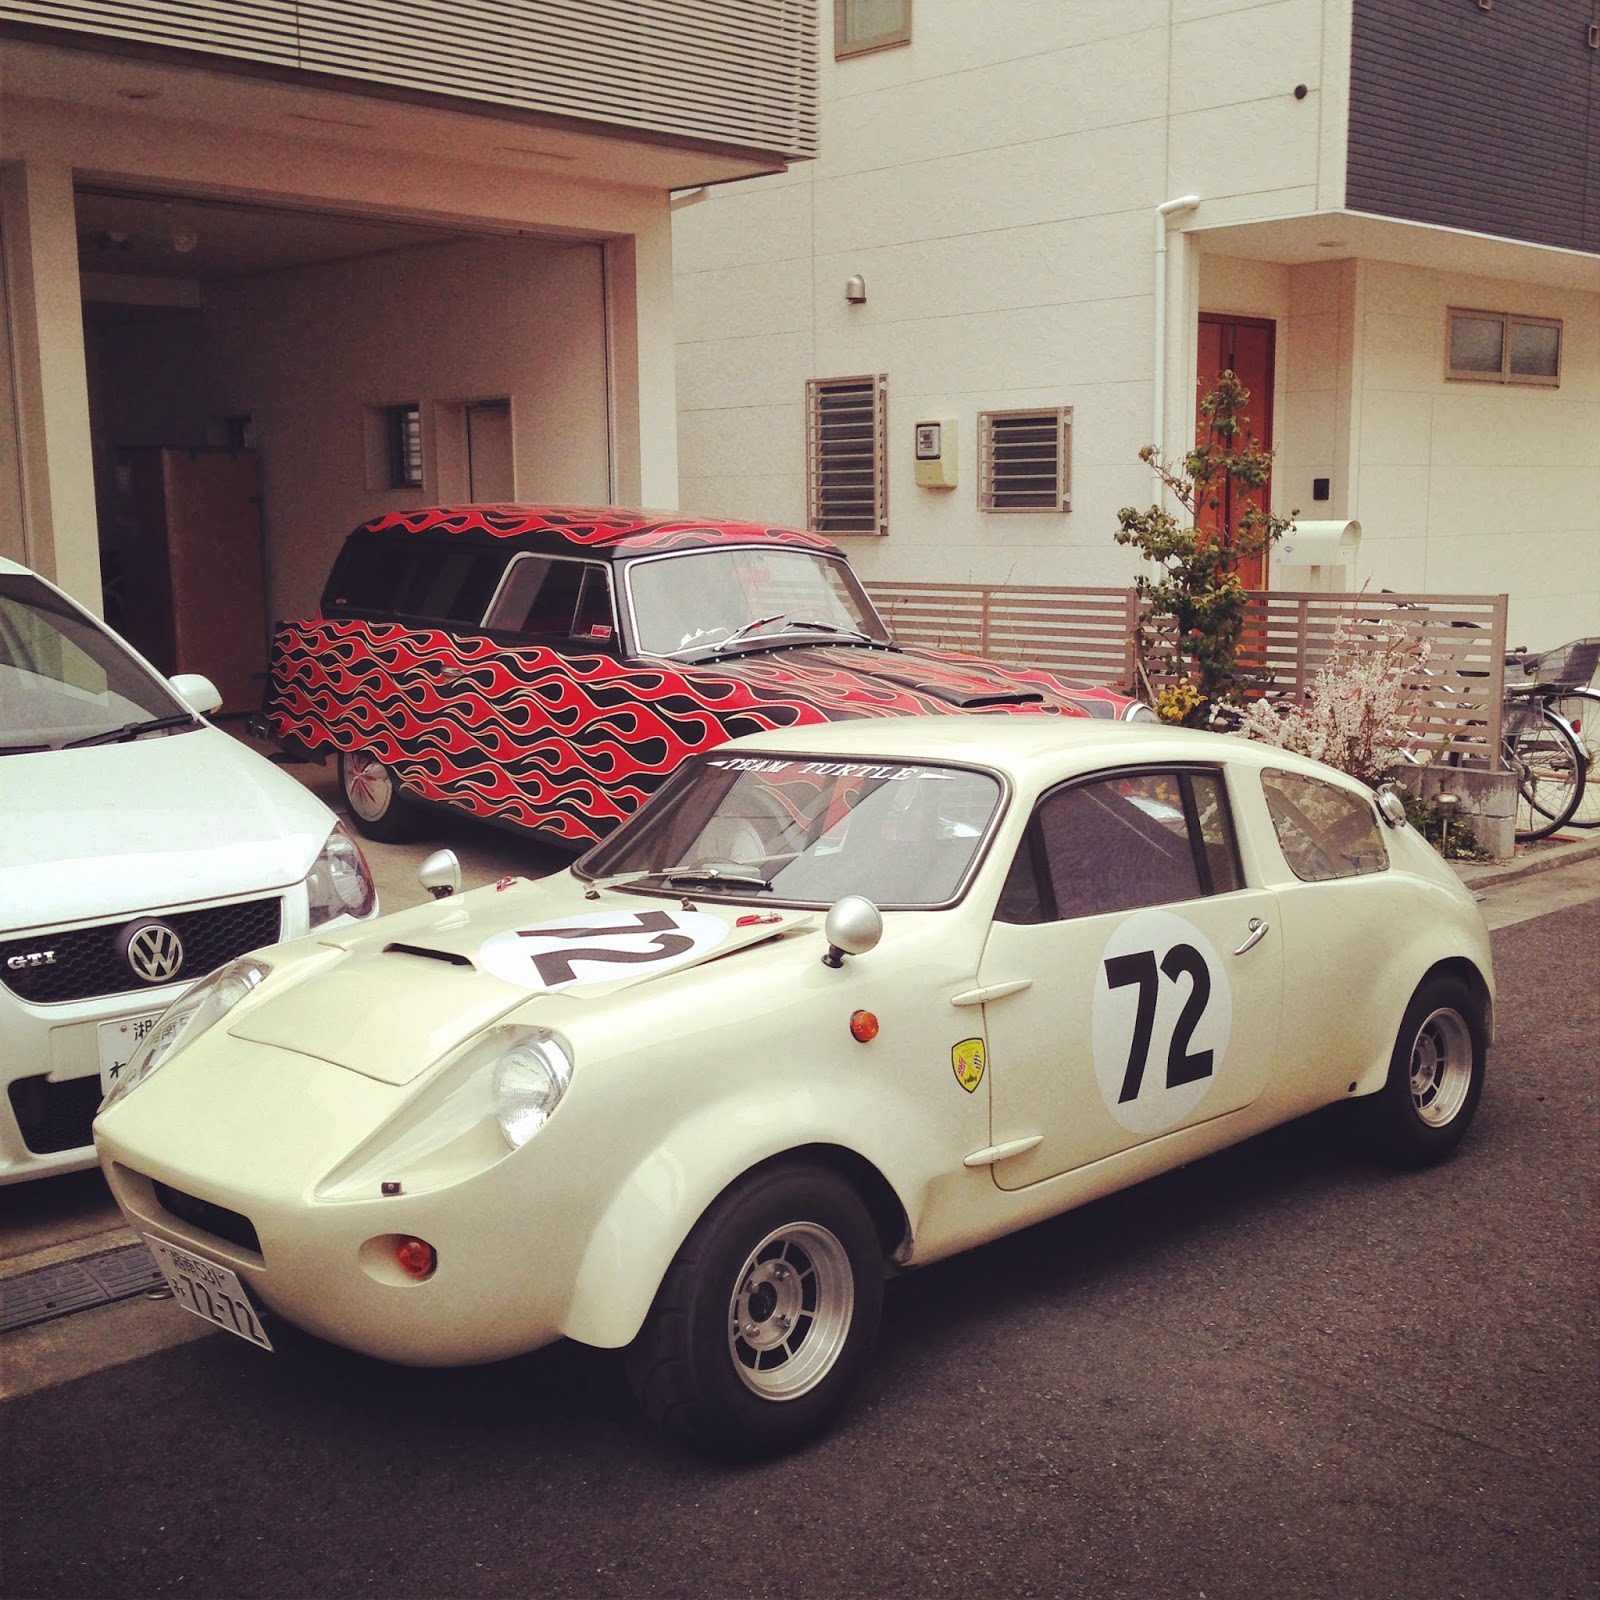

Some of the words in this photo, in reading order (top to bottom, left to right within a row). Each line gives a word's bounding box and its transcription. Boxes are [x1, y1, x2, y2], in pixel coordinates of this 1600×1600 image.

[721, 758, 794, 773] TEAM
[798, 762, 918, 781] TURTLE
[7, 950, 57, 970] GTI
[516, 910, 695, 987] 72
[1103, 943, 1214, 1105] 72
[177, 1271, 266, 1344] 72-72
